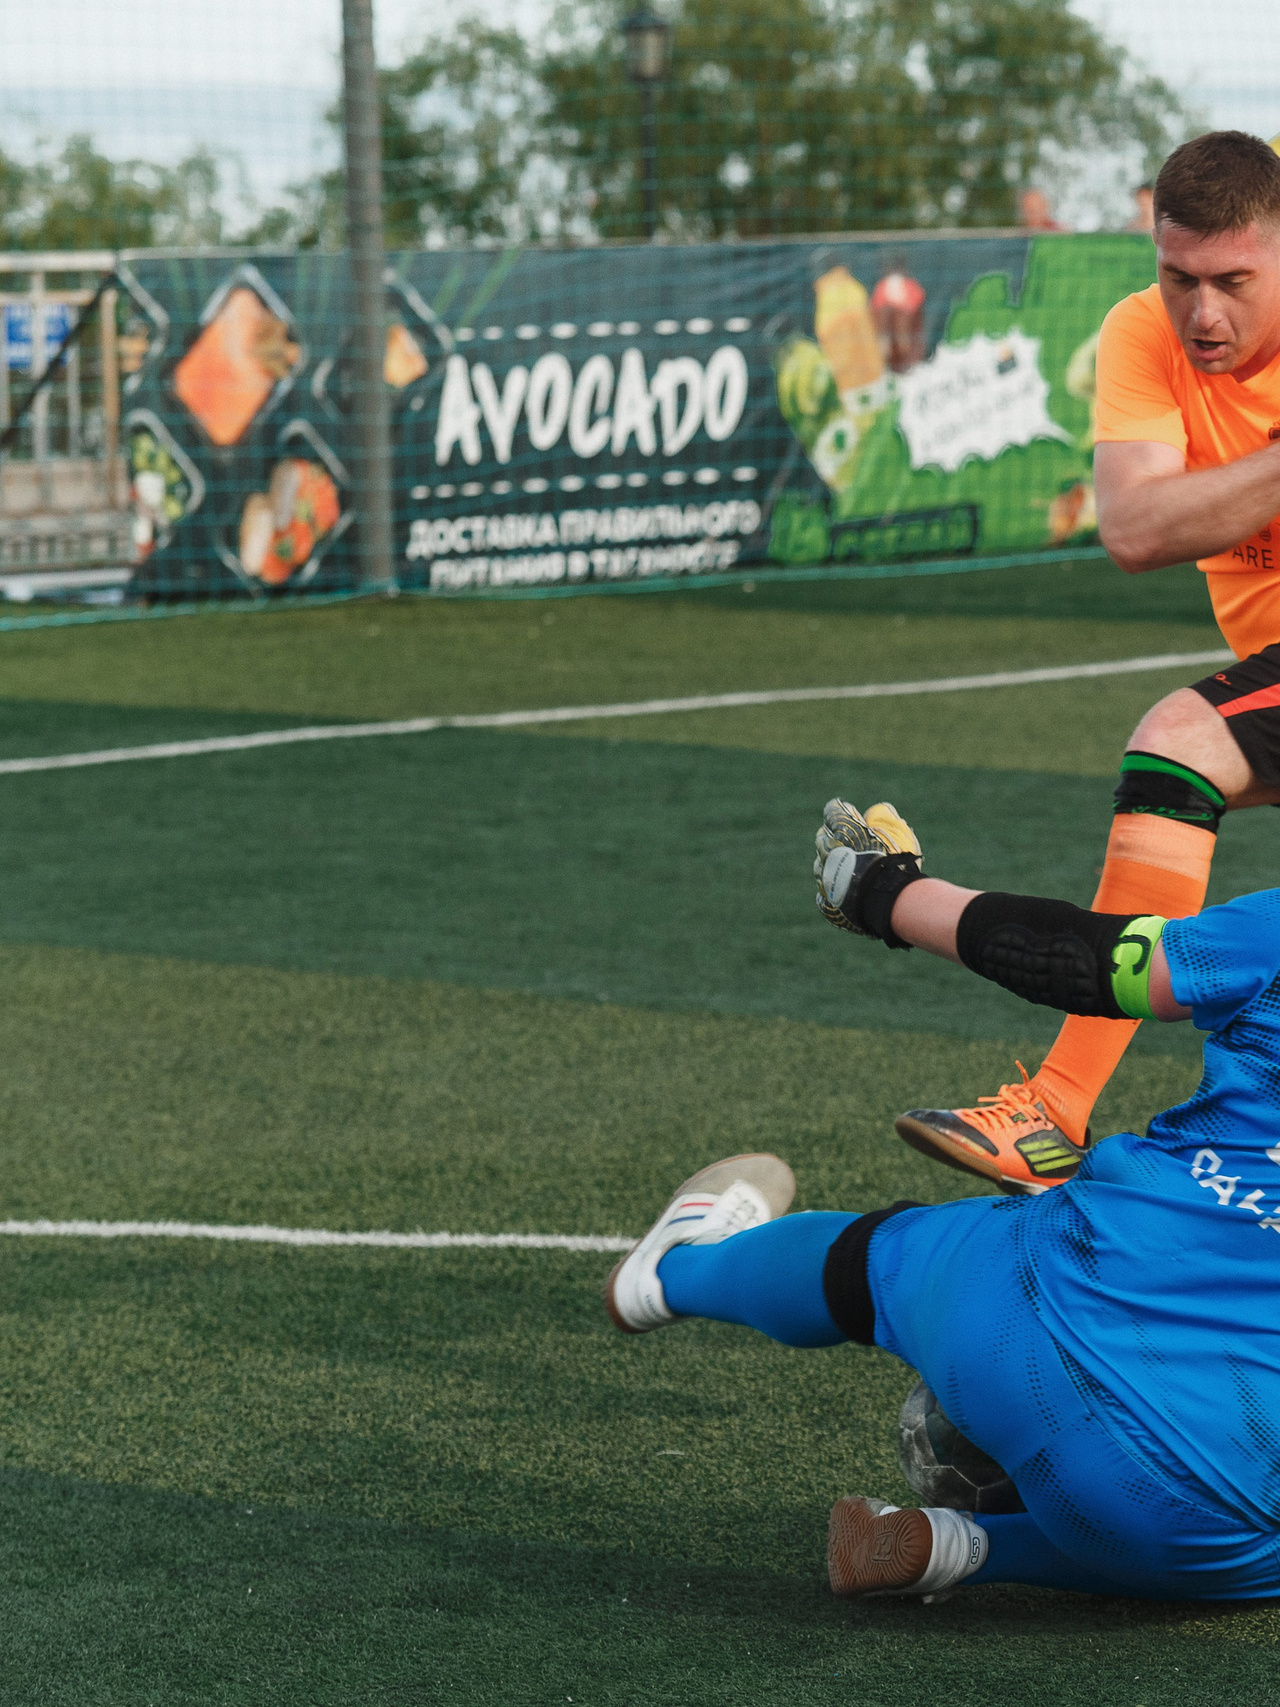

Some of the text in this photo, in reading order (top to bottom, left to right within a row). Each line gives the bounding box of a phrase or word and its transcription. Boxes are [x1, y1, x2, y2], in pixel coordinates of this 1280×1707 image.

[435, 346, 748, 466] AVOCADO
[406, 500, 761, 561] ДОСТАВКА ПРАВИЛЬНОГО
[1232, 545, 1274, 569] ARE
